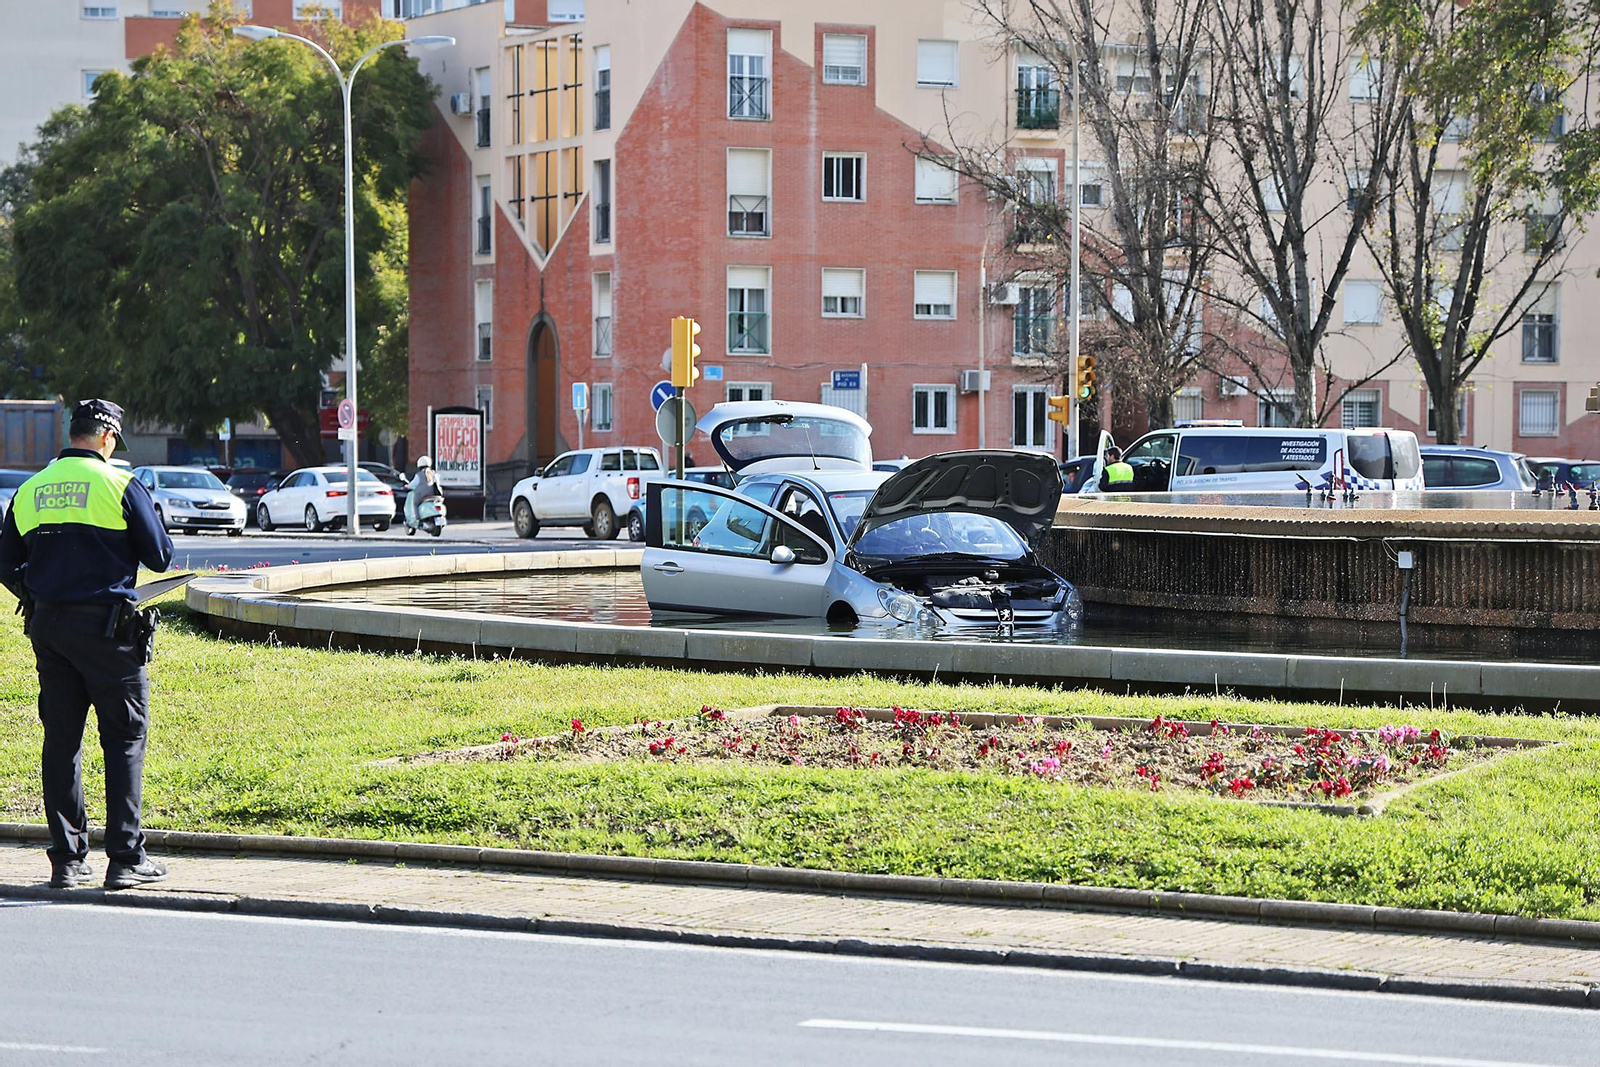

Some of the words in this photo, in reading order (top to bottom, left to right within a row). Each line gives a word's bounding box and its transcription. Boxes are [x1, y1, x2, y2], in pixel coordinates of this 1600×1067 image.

[437, 417, 464, 427] SIEMPRE
[437, 427, 479, 447] HUECO
[463, 447, 478, 461] UNA
[36, 483, 86, 497] POLICIA
[40, 495, 80, 507] LOCAL
